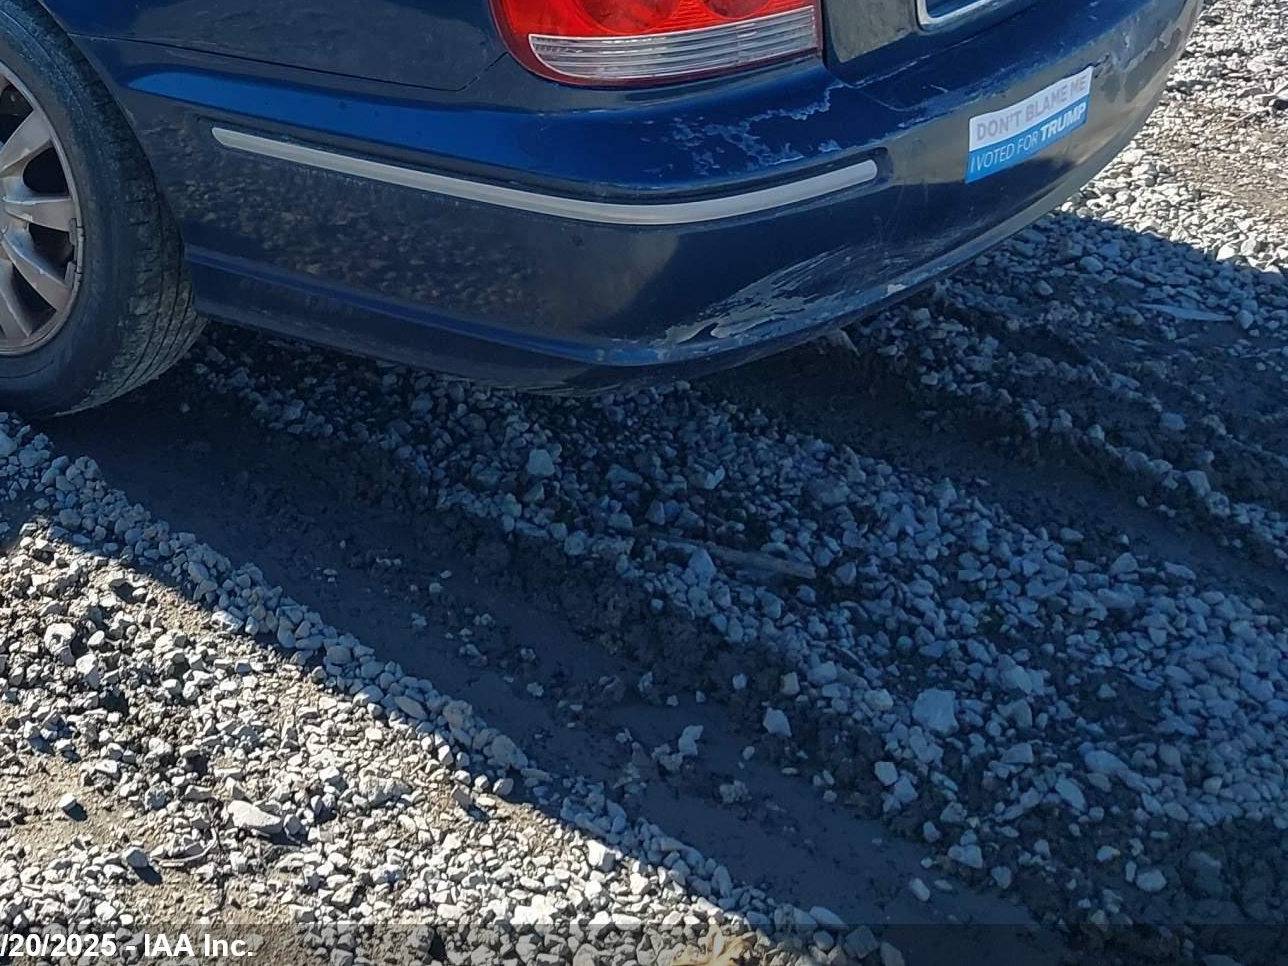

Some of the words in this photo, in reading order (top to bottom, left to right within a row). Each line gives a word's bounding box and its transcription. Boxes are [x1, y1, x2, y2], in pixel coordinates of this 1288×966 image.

[970, 157, 975, 173] I
[976, 143, 1016, 171] VOTED
[1017, 130, 1039, 155] FOR
[1040, 101, 1087, 141] TRUMP
[976, 109, 1023, 141] DON'T
[1025, 84, 1068, 123] BLAME
[1071, 75, 1088, 97] ME
